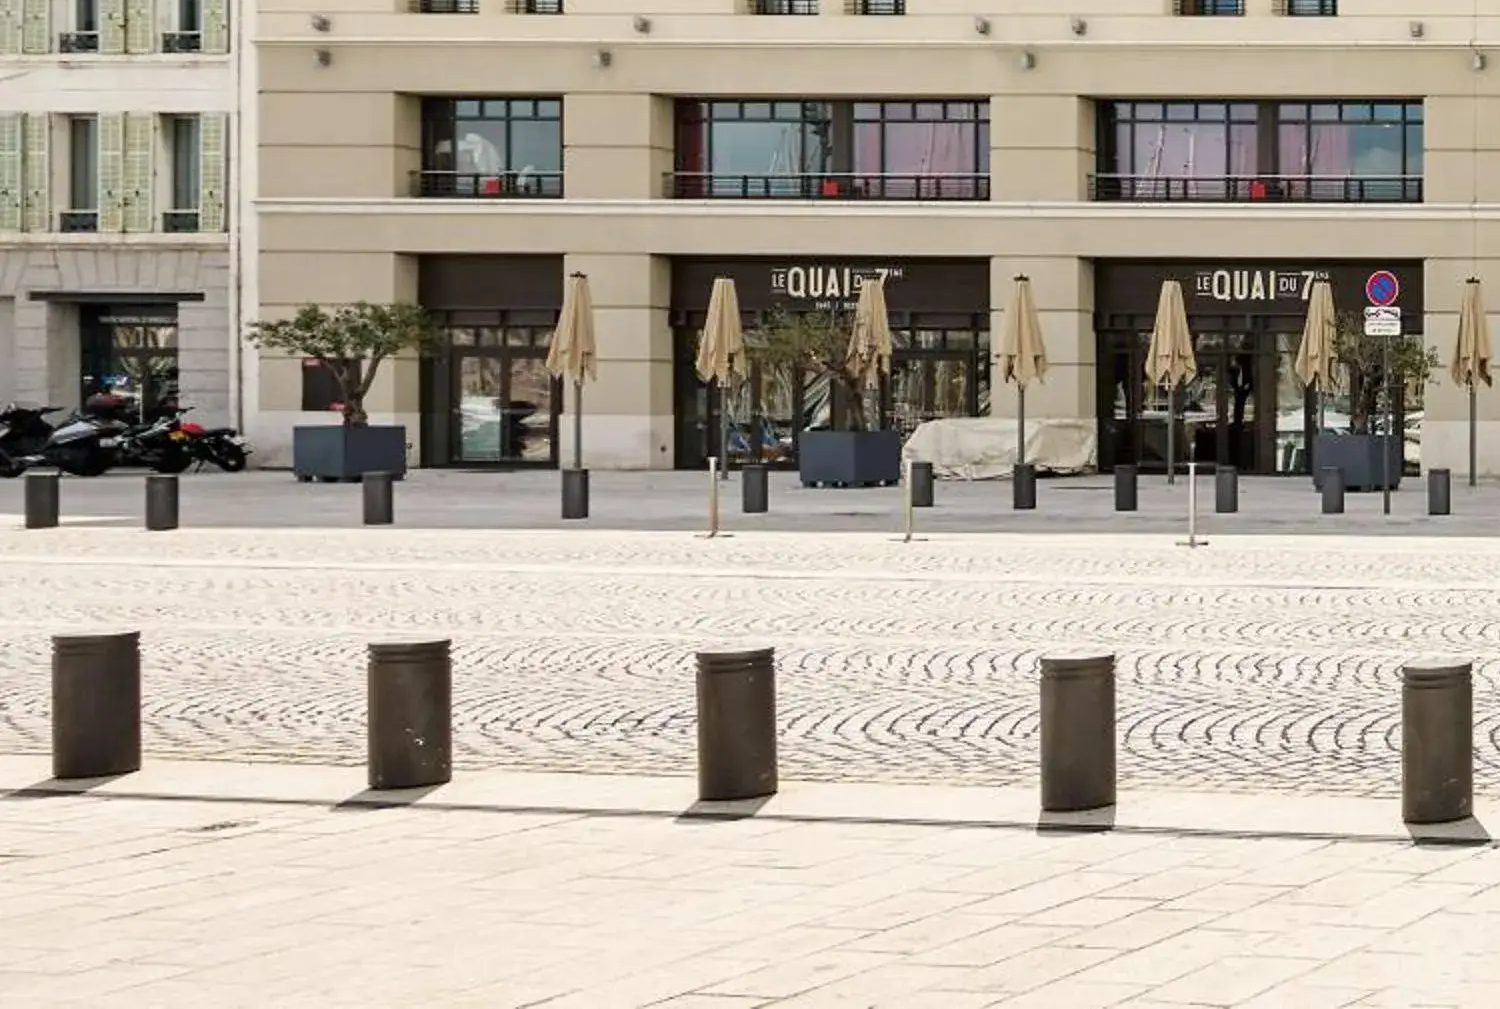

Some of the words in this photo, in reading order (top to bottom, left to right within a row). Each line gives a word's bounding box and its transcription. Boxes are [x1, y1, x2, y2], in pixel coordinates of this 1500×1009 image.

[771, 273, 785, 288] LE
[787, 266, 851, 298] QUAI
[1197, 276, 1210, 290] LE
[1212, 270, 1275, 301] QUAI
[1280, 277, 1297, 291] DU
